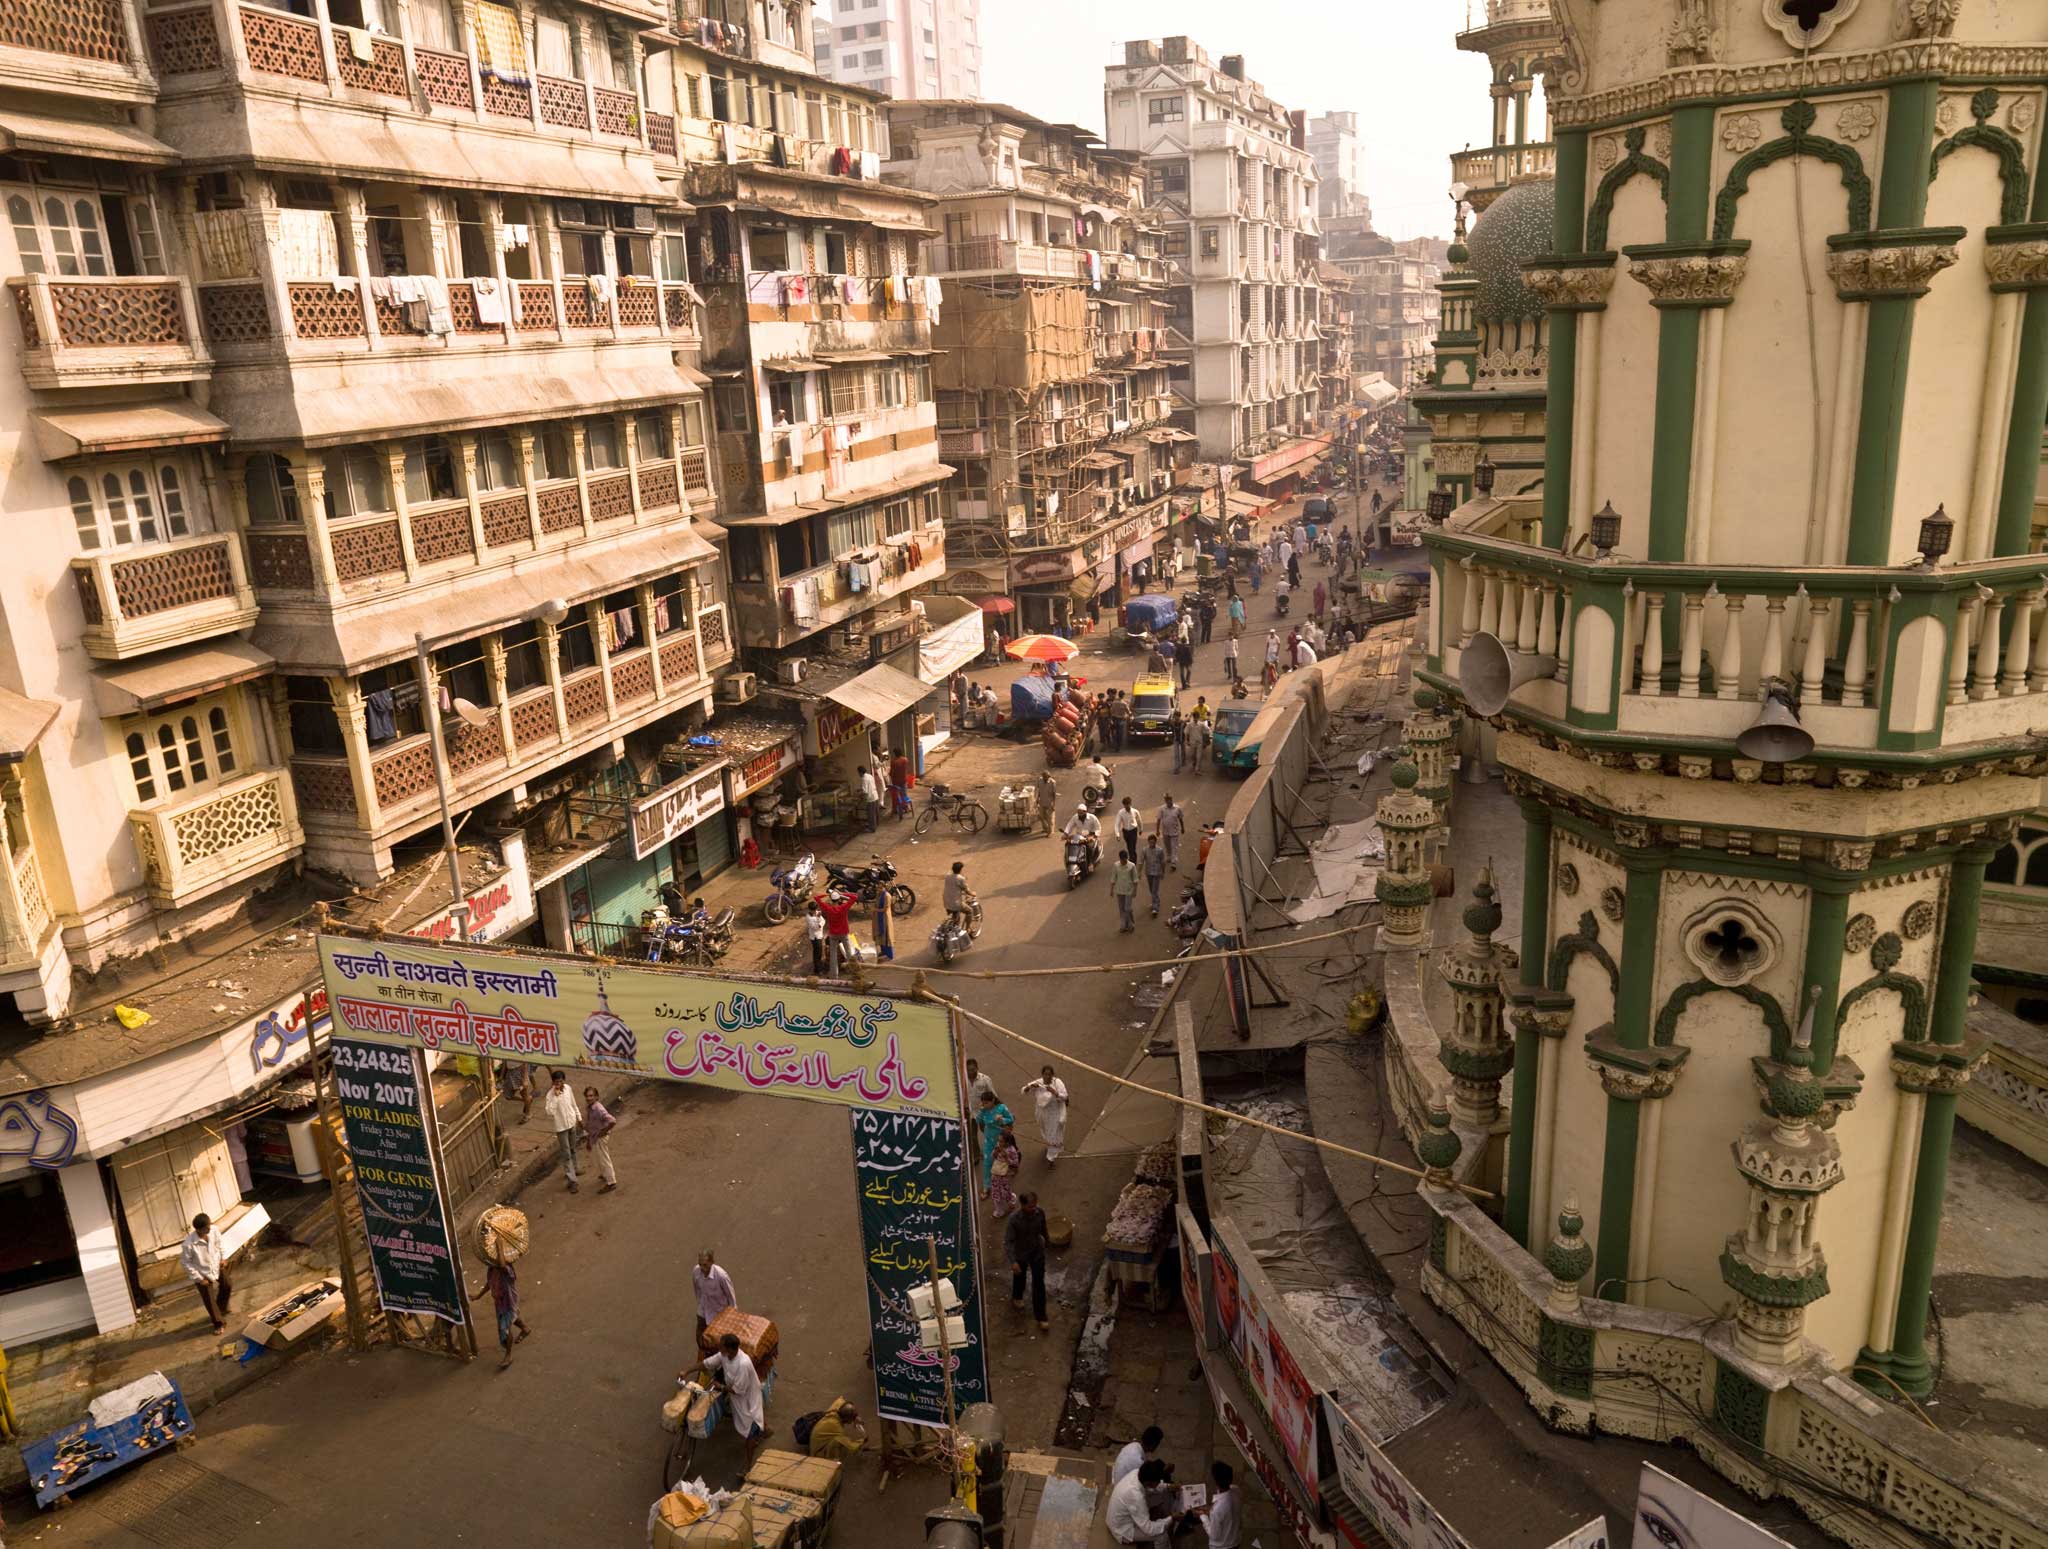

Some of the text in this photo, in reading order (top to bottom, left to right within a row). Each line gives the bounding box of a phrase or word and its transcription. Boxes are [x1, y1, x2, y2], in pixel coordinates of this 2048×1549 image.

[332, 951, 557, 998] सुन्नी दाअवते इस्लामी
[377, 985, 392, 998] का
[394, 984, 416, 1000] तीन
[337, 996, 411, 1035] सालाना
[412, 999, 471, 1049] सुन्नी
[471, 1004, 560, 1055] इजतिमा
[332, 1046, 413, 1075] 23,24&25
[663, 1028, 745, 1079] اجتماع
[776, 1051, 861, 1091] سالانہ
[857, 1033, 929, 1102] عالمی
[338, 1078, 414, 1107] Nov 2007
[345, 1105, 421, 1128] FOR LADIES
[360, 1123, 411, 1139] Friday 23 Nov
[380, 1139, 397, 1149] After
[403, 1153, 414, 1163] till
[357, 1166, 434, 1189] FOR GENTS
[366, 1184, 423, 1200] Saturday 24 Nov
[403, 1201, 414, 1211] till
[880, 1386, 908, 1400] FRIENDS
[910, 1392, 934, 1405] ACTIVE
